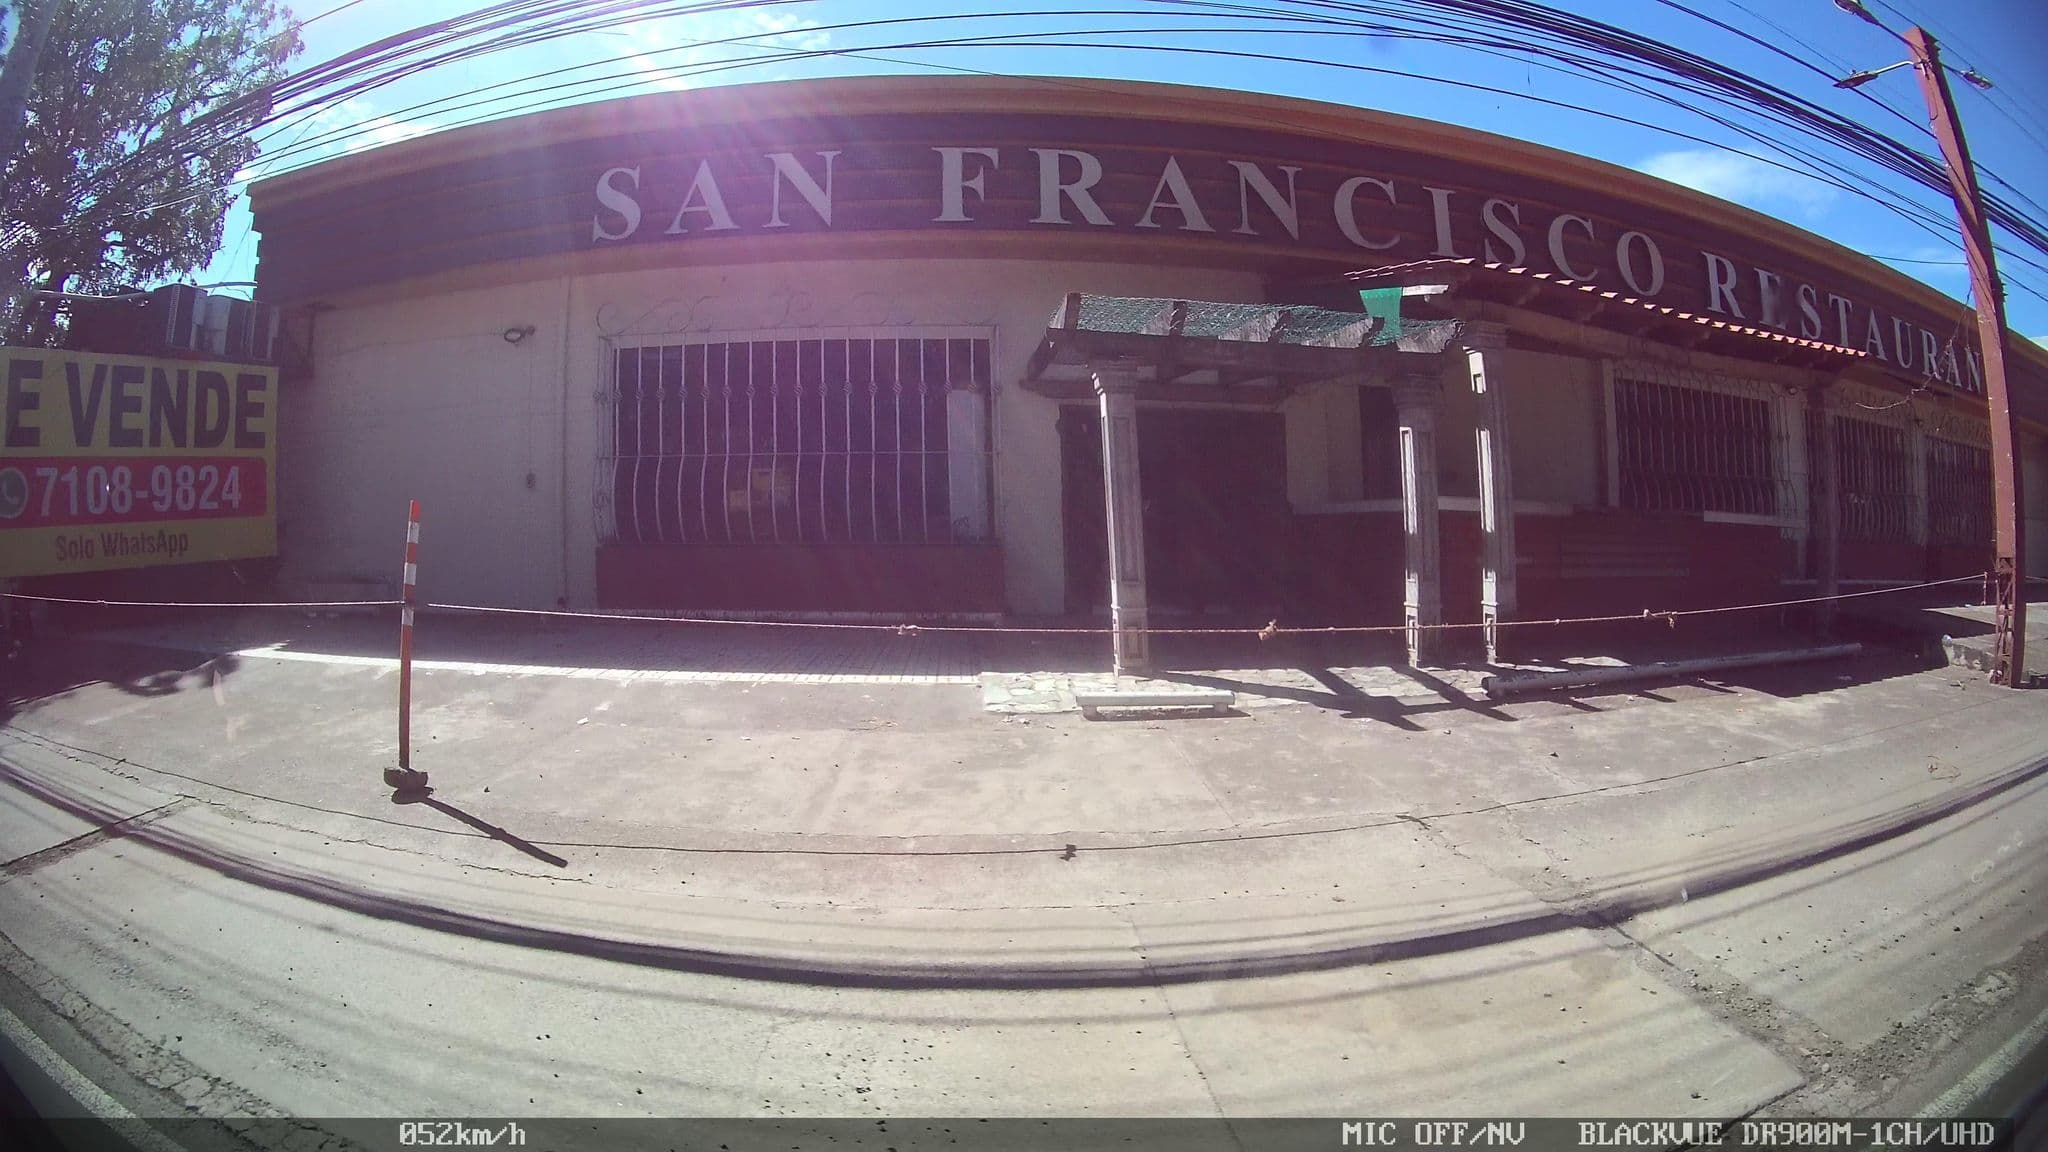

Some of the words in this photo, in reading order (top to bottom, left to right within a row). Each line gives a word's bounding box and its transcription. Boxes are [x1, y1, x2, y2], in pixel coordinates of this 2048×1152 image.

[592, 150, 843, 243] SAN
[931, 146, 1666, 297] FRANCISCO
[1701, 251, 1981, 393] RESTAURAN
[5, 359, 44, 447] E
[64, 362, 267, 448] VENDE
[36, 465, 241, 517] 7108-9824
[56, 535, 94, 561] Solo
[101, 529, 188, 558] WhatsApp
